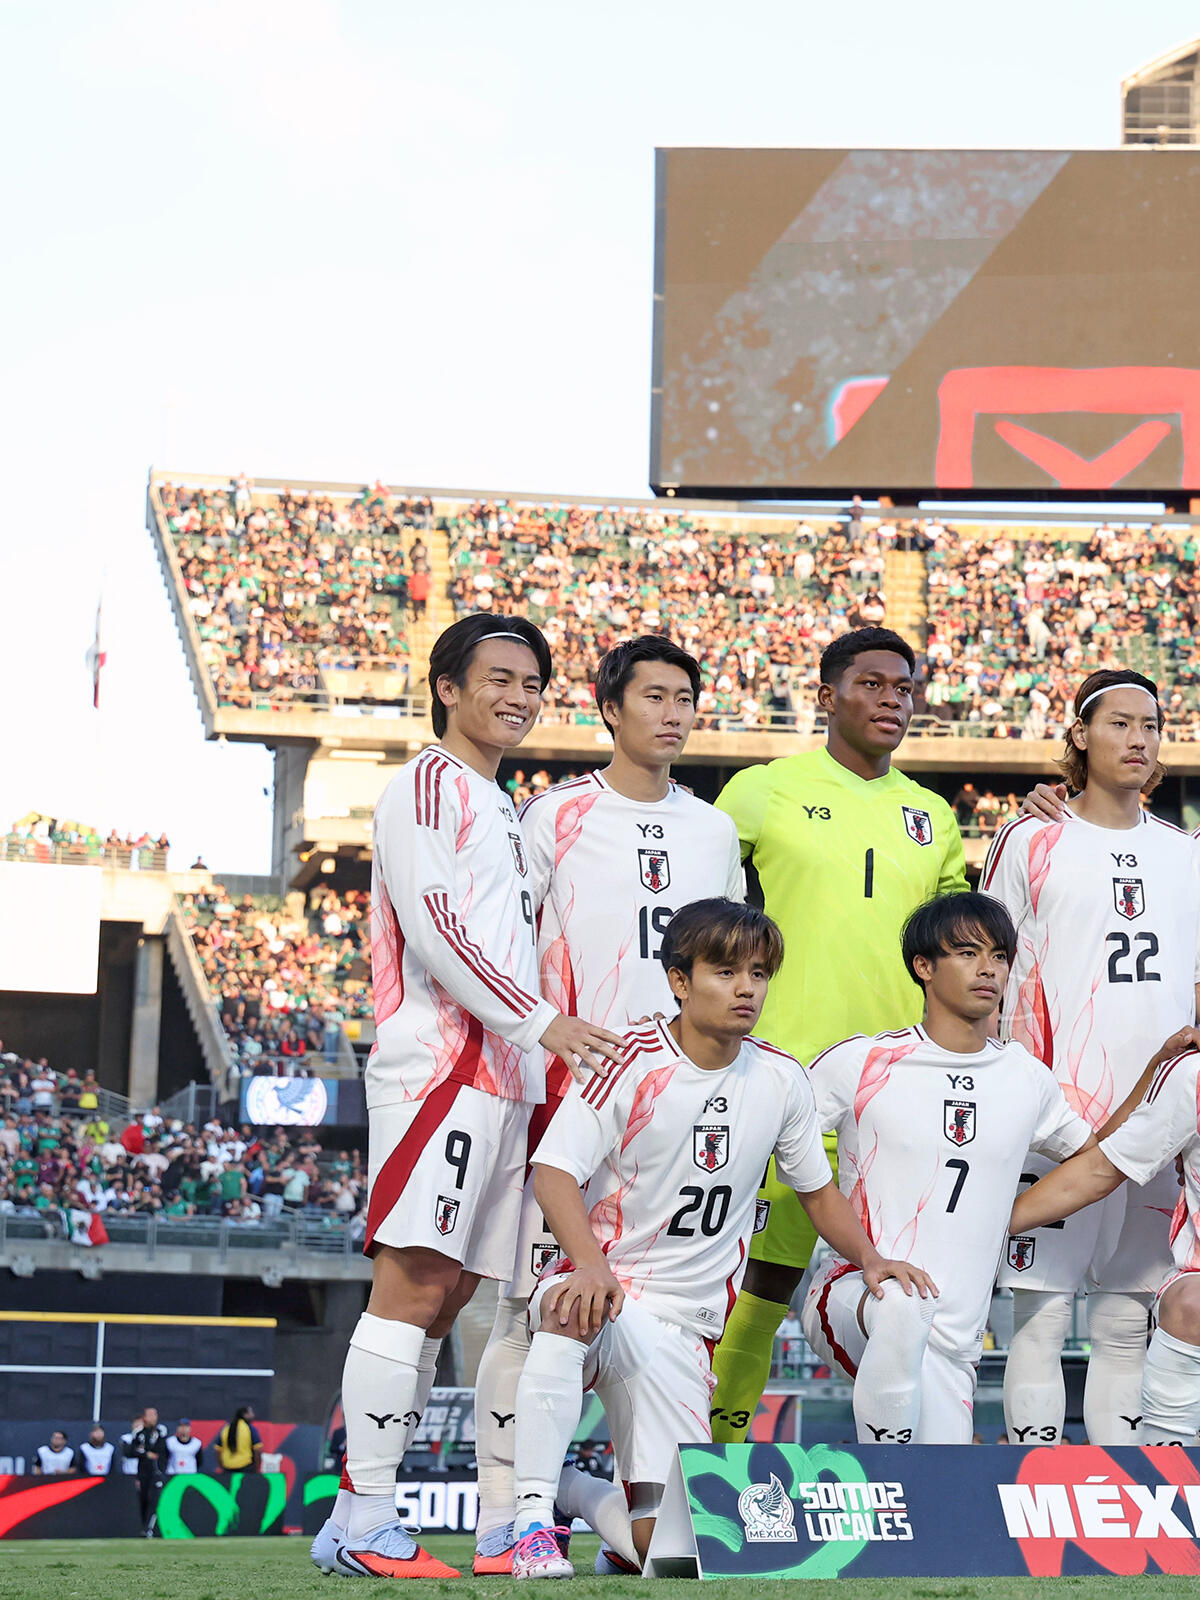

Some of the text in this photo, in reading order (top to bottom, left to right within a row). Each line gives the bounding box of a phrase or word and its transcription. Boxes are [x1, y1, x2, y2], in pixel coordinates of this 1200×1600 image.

[803, 806, 831, 820] Y-3
[636, 824, 664, 839] Y-3
[1110, 853, 1138, 867] Y-3
[864, 848, 873, 898] 1
[1106, 932, 1161, 983] 22
[946, 1074, 974, 1091] Y-3
[445, 1130, 472, 1190] 9
[945, 1158, 970, 1213] 7
[667, 1185, 732, 1237] 20
[865, 1423, 912, 1444] Y-3
[1012, 1426, 1057, 1442] Y-3
[750, 1528, 793, 1539] MÉXICO
[805, 1512, 914, 1541] LOCALES
